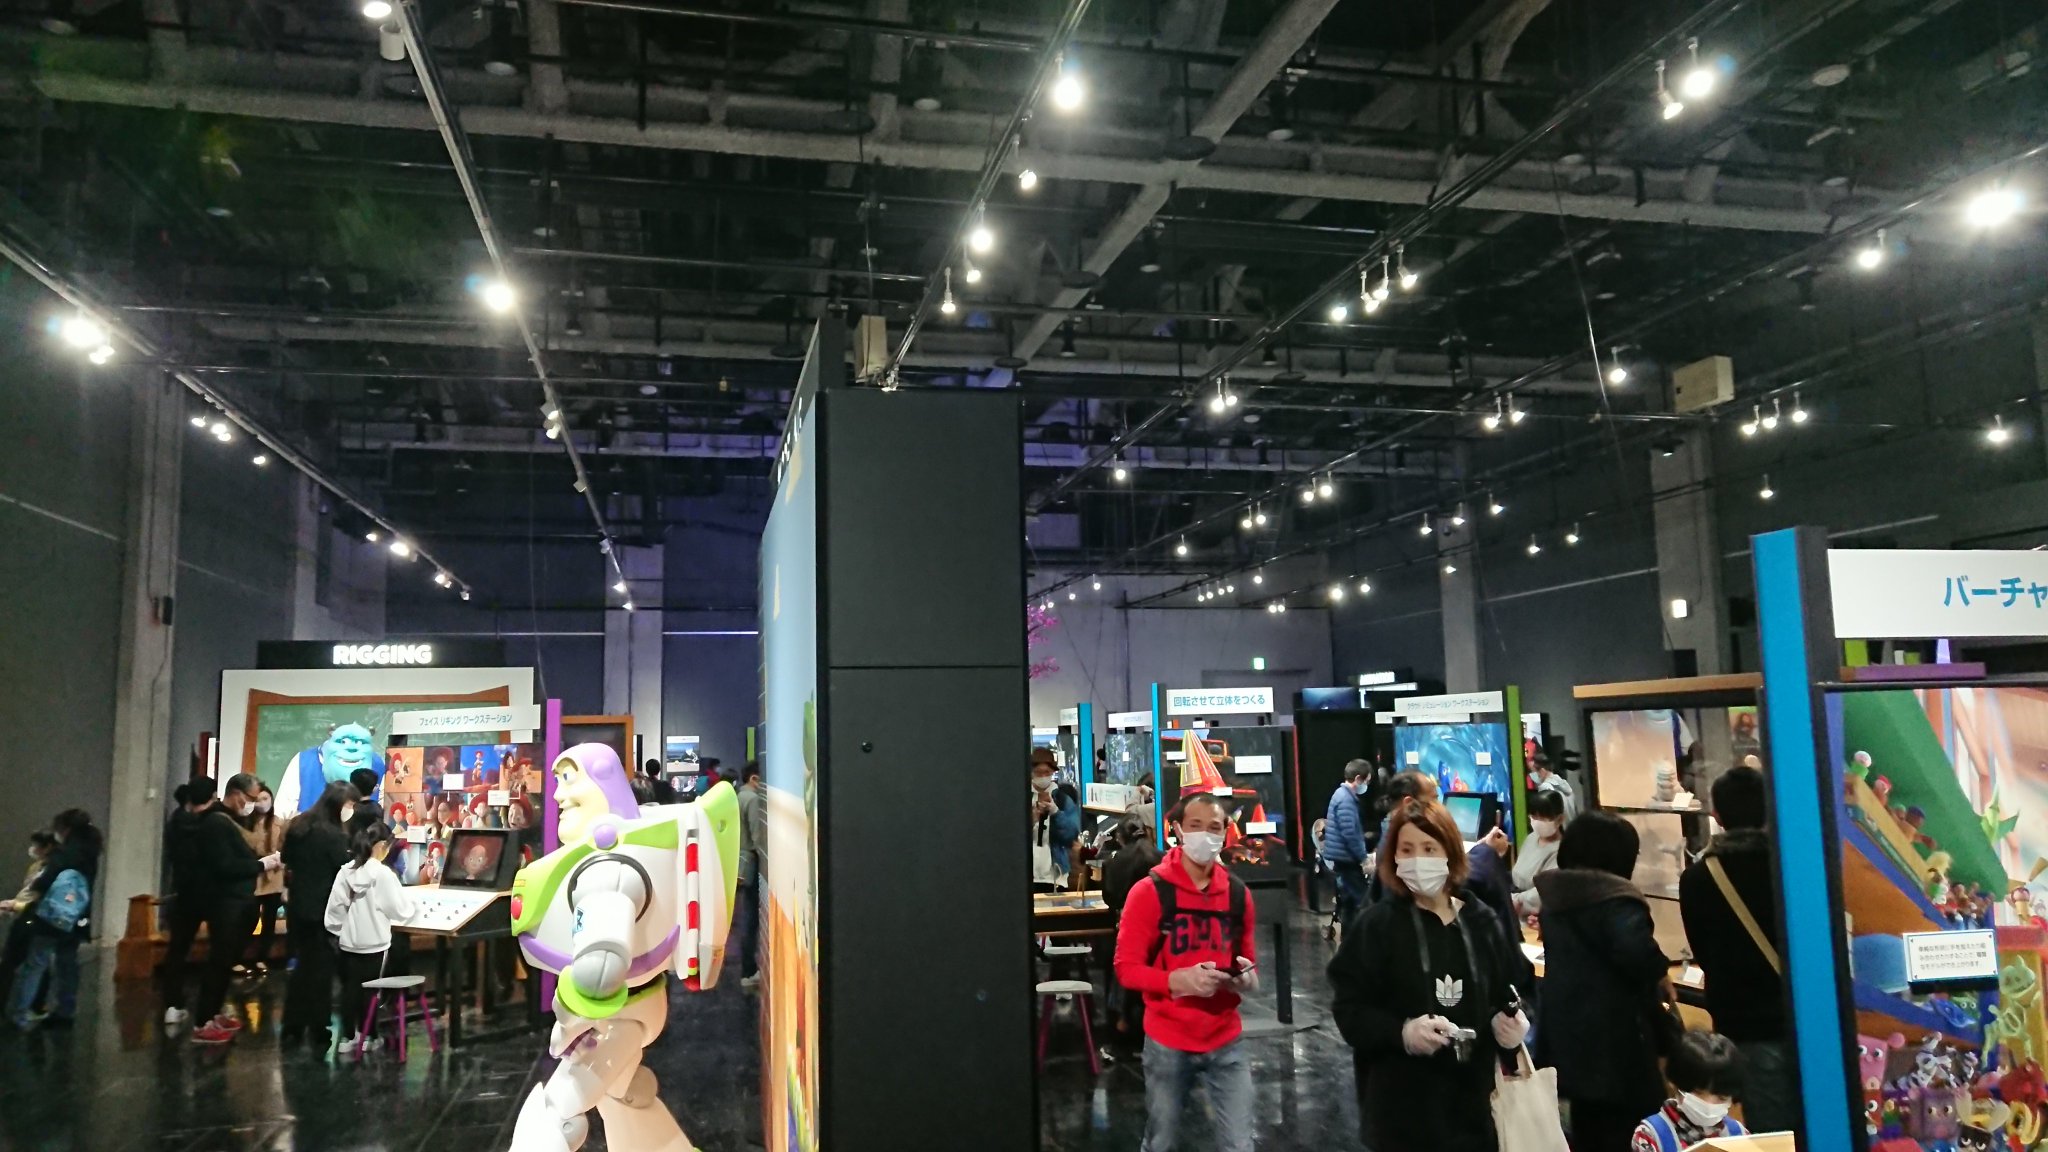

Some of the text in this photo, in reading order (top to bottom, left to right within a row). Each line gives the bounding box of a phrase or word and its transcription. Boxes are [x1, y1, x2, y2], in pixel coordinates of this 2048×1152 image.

[1943, 575, 2048, 608] バーチャ
[333, 644, 432, 665] RIGGING
[1173, 694, 1265, 707] 回転させて立体をつくる
[418, 716, 439, 727] フェイス
[463, 713, 513, 725] ワークステーション
